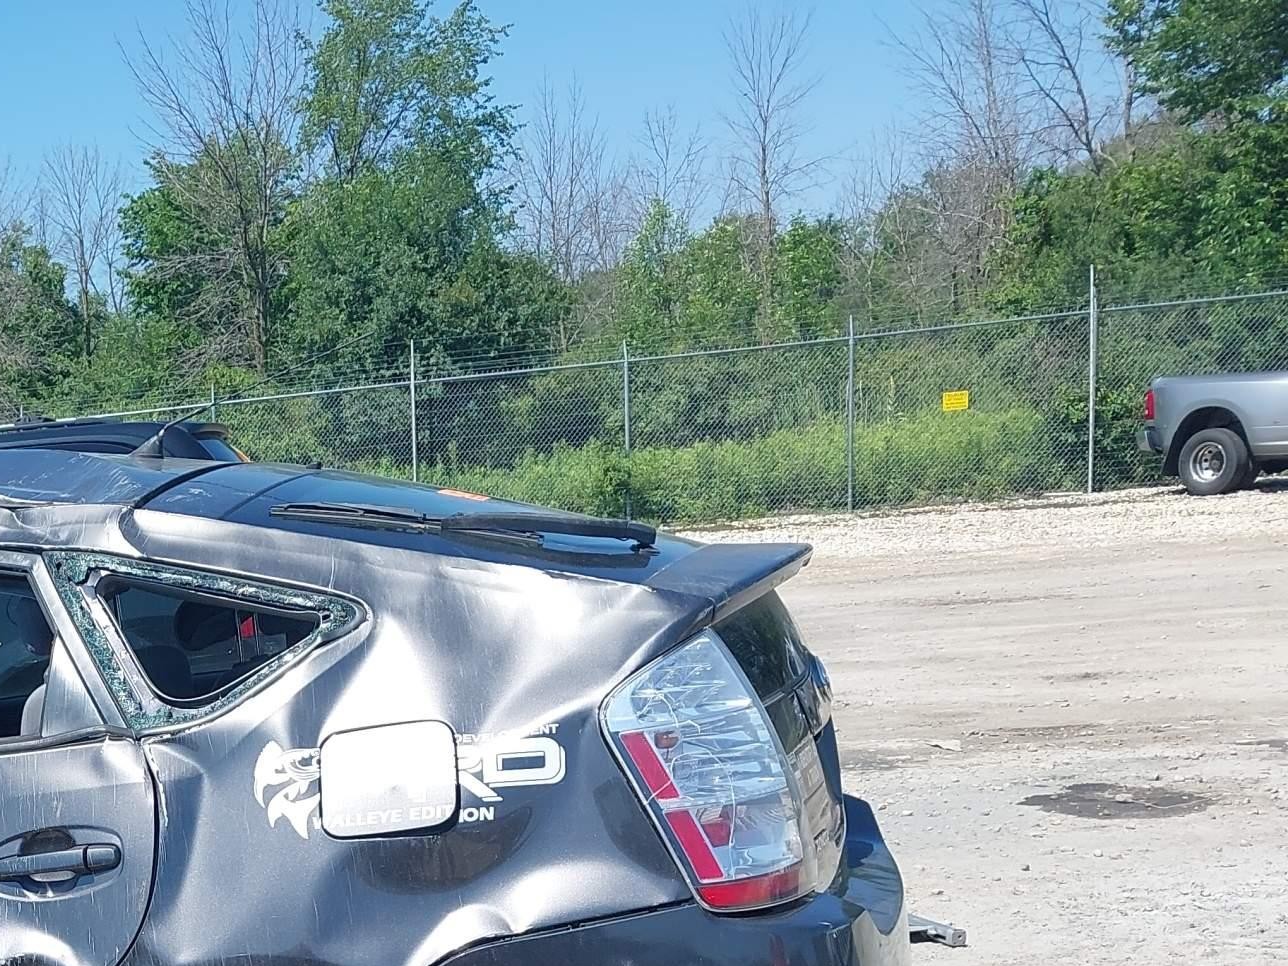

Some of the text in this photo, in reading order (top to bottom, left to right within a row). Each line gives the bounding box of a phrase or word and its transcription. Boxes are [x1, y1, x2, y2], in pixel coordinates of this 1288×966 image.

[456, 723, 559, 745] DEVELENT
[312, 806, 495, 830] WALLEYE EDITION
